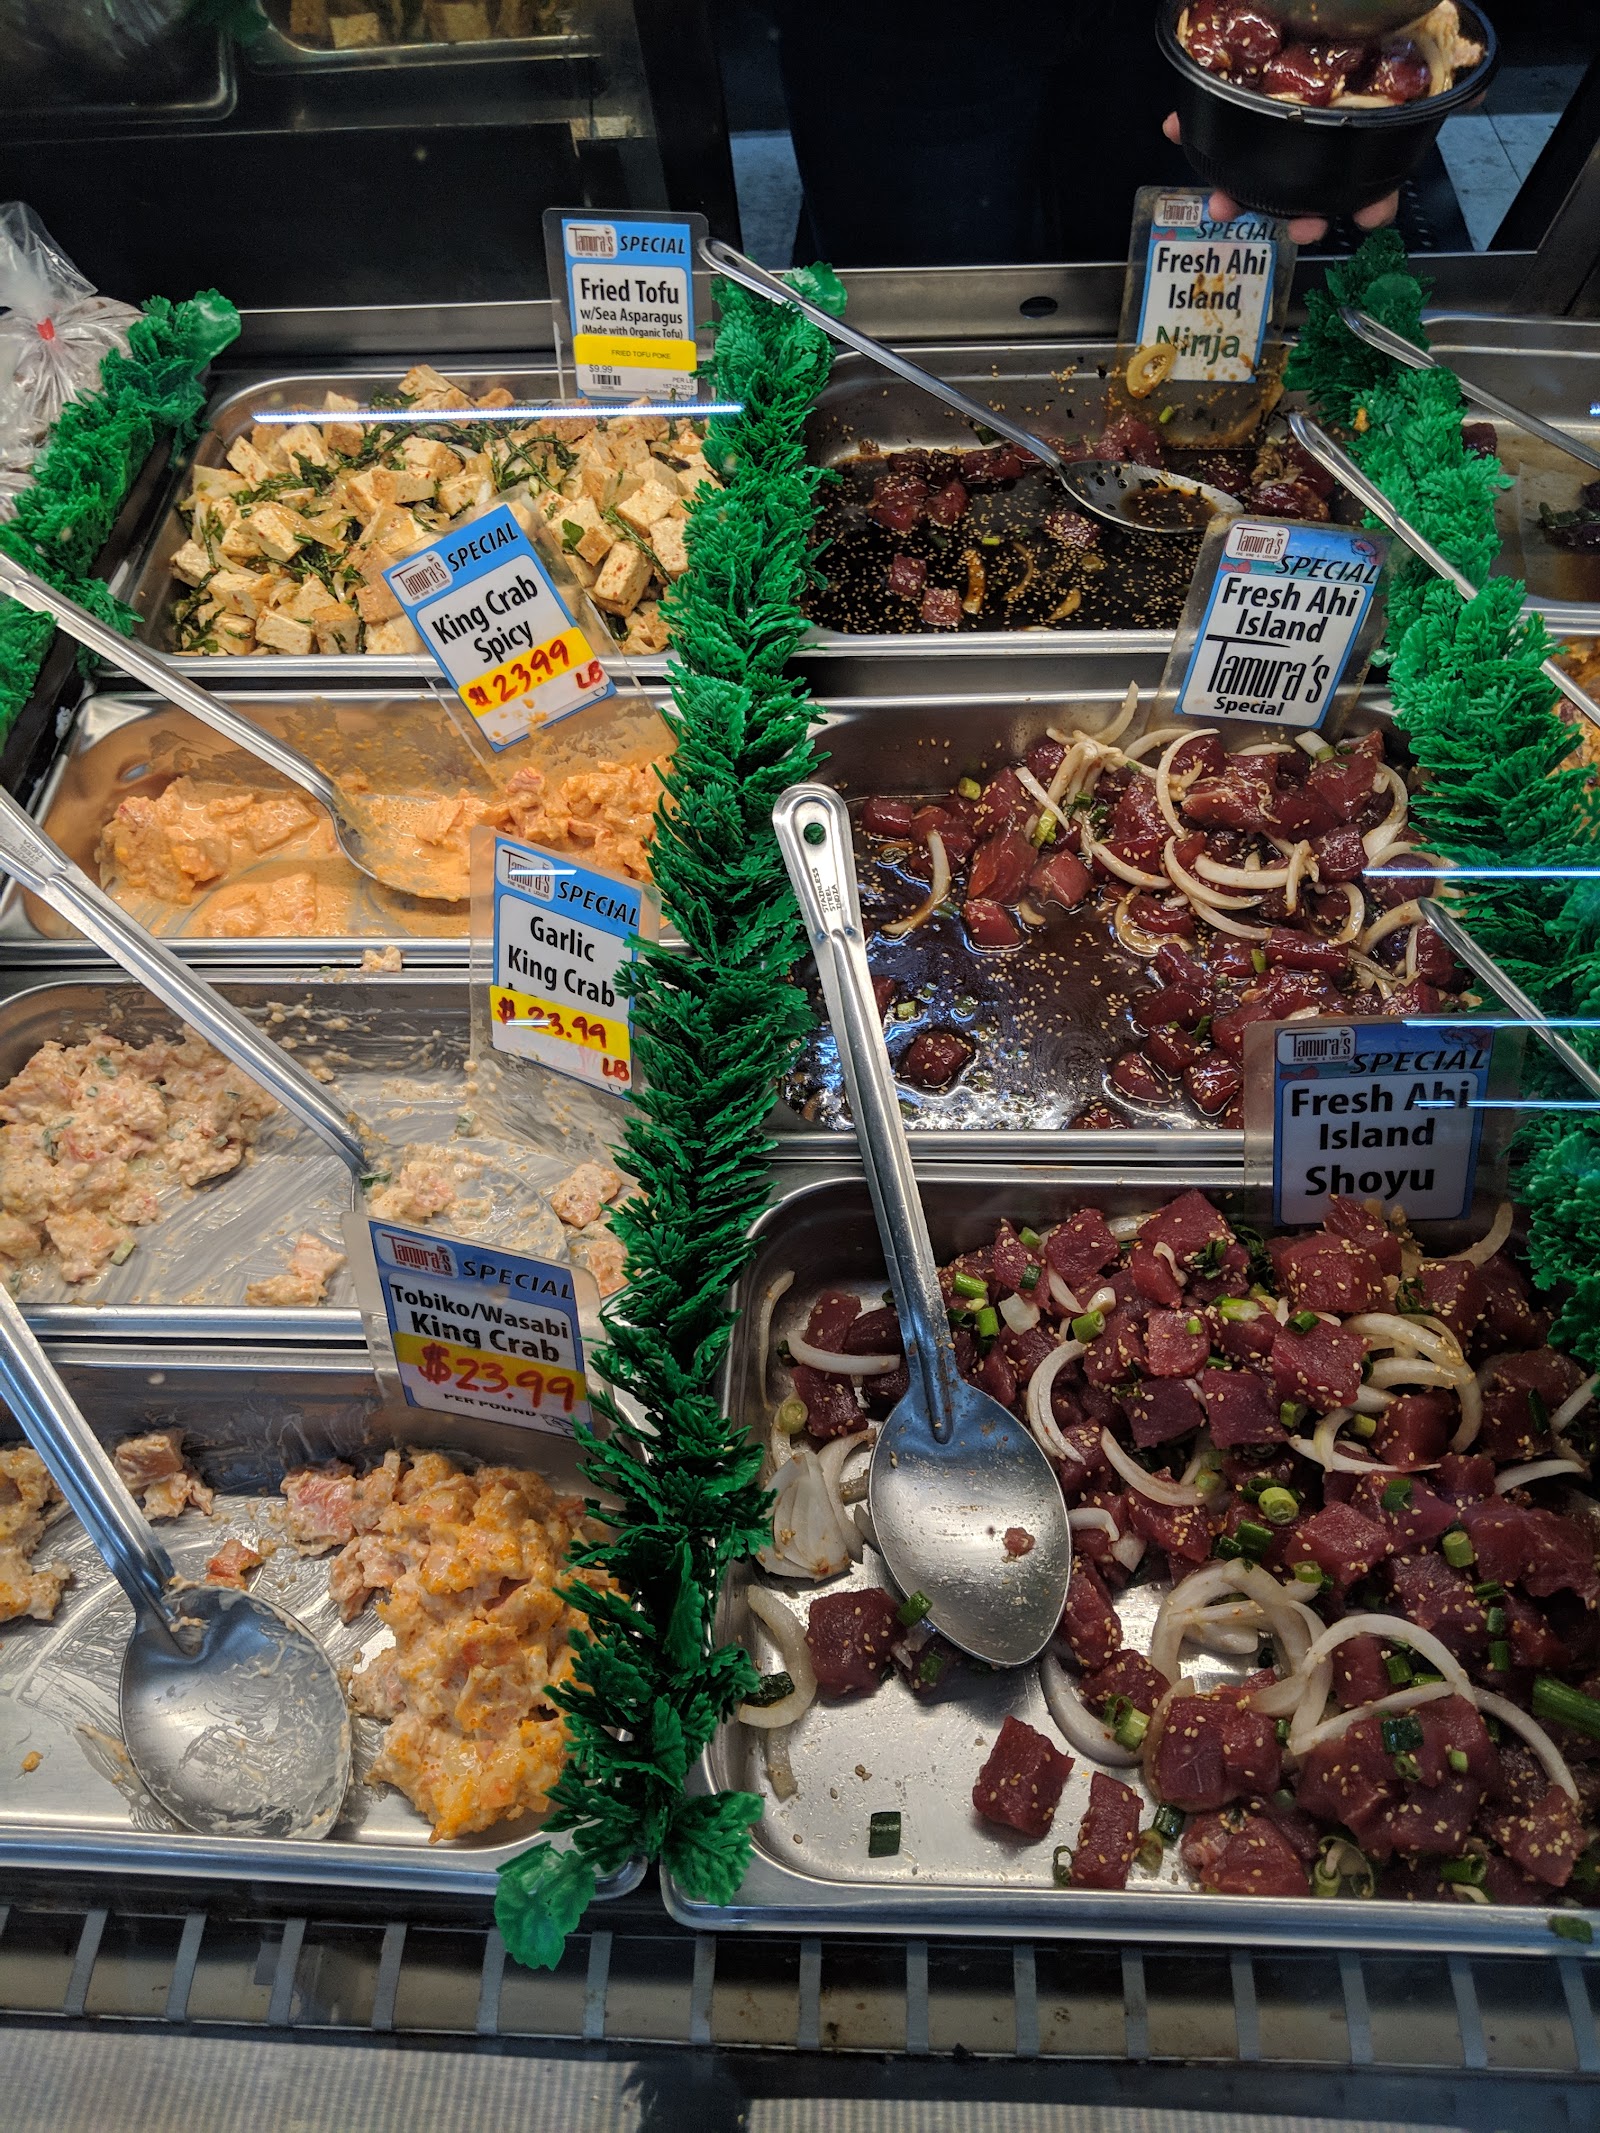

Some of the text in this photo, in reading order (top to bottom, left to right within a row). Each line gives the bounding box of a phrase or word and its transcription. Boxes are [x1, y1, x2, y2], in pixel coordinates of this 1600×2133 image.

[1160, 198, 1200, 220] Tamura's
[568, 227, 614, 253] Tamura's
[620, 235, 686, 255] SPECIAL
[1197, 221, 1278, 241] SPECIAL
[1157, 247, 1267, 275] Fresh Ahi
[580, 277, 679, 304] Fried Tofu
[1169, 283, 1241, 311] Island
[580, 306, 683, 327] w/Sea Asparagus
[581, 324, 683, 340] (Made with Organic Tofu)
[611, 349, 631, 357] FRIED
[1156, 325, 1240, 366] Ninja
[589, 364, 613, 374] $9.99
[448, 522, 519, 573] SPECIAL
[1236, 526, 1284, 555] Tamura's
[391, 561, 447, 597] Tamura's
[1275, 555, 1379, 584] SPECIAL
[431, 605, 491, 645] King
[486, 575, 539, 616] Crab
[1222, 577, 1360, 617] Fresh Ahi
[474, 620, 534, 663] Spicy
[1235, 609, 1329, 643] Island
[576, 660, 603, 690] LB
[1205, 634, 1330, 704] Tamura's
[1213, 696, 1285, 716] Special
[557, 881, 638, 927] SPECIAL
[530, 916, 595, 962] Garlic
[508, 944, 615, 1008] King Crab
[1284, 1032, 1351, 1058] Tamura's
[602, 1057, 630, 1082] LB
[1350, 1049, 1486, 1074] SPECIAL
[1291, 1080, 1470, 1117] Fresh Ahi
[1319, 1117, 1436, 1150] Island
[1304, 1164, 1435, 1201] Shoyu
[381, 1232, 453, 1272] Tamura's
[462, 1261, 575, 1300] SPECIAL
[390, 1283, 569, 1340] Tobiko/Wasabi
[410, 1311, 560, 1363] King Crab
[418, 1342, 575, 1412] $23.99
[443, 1393, 536, 1417] PER POUND
